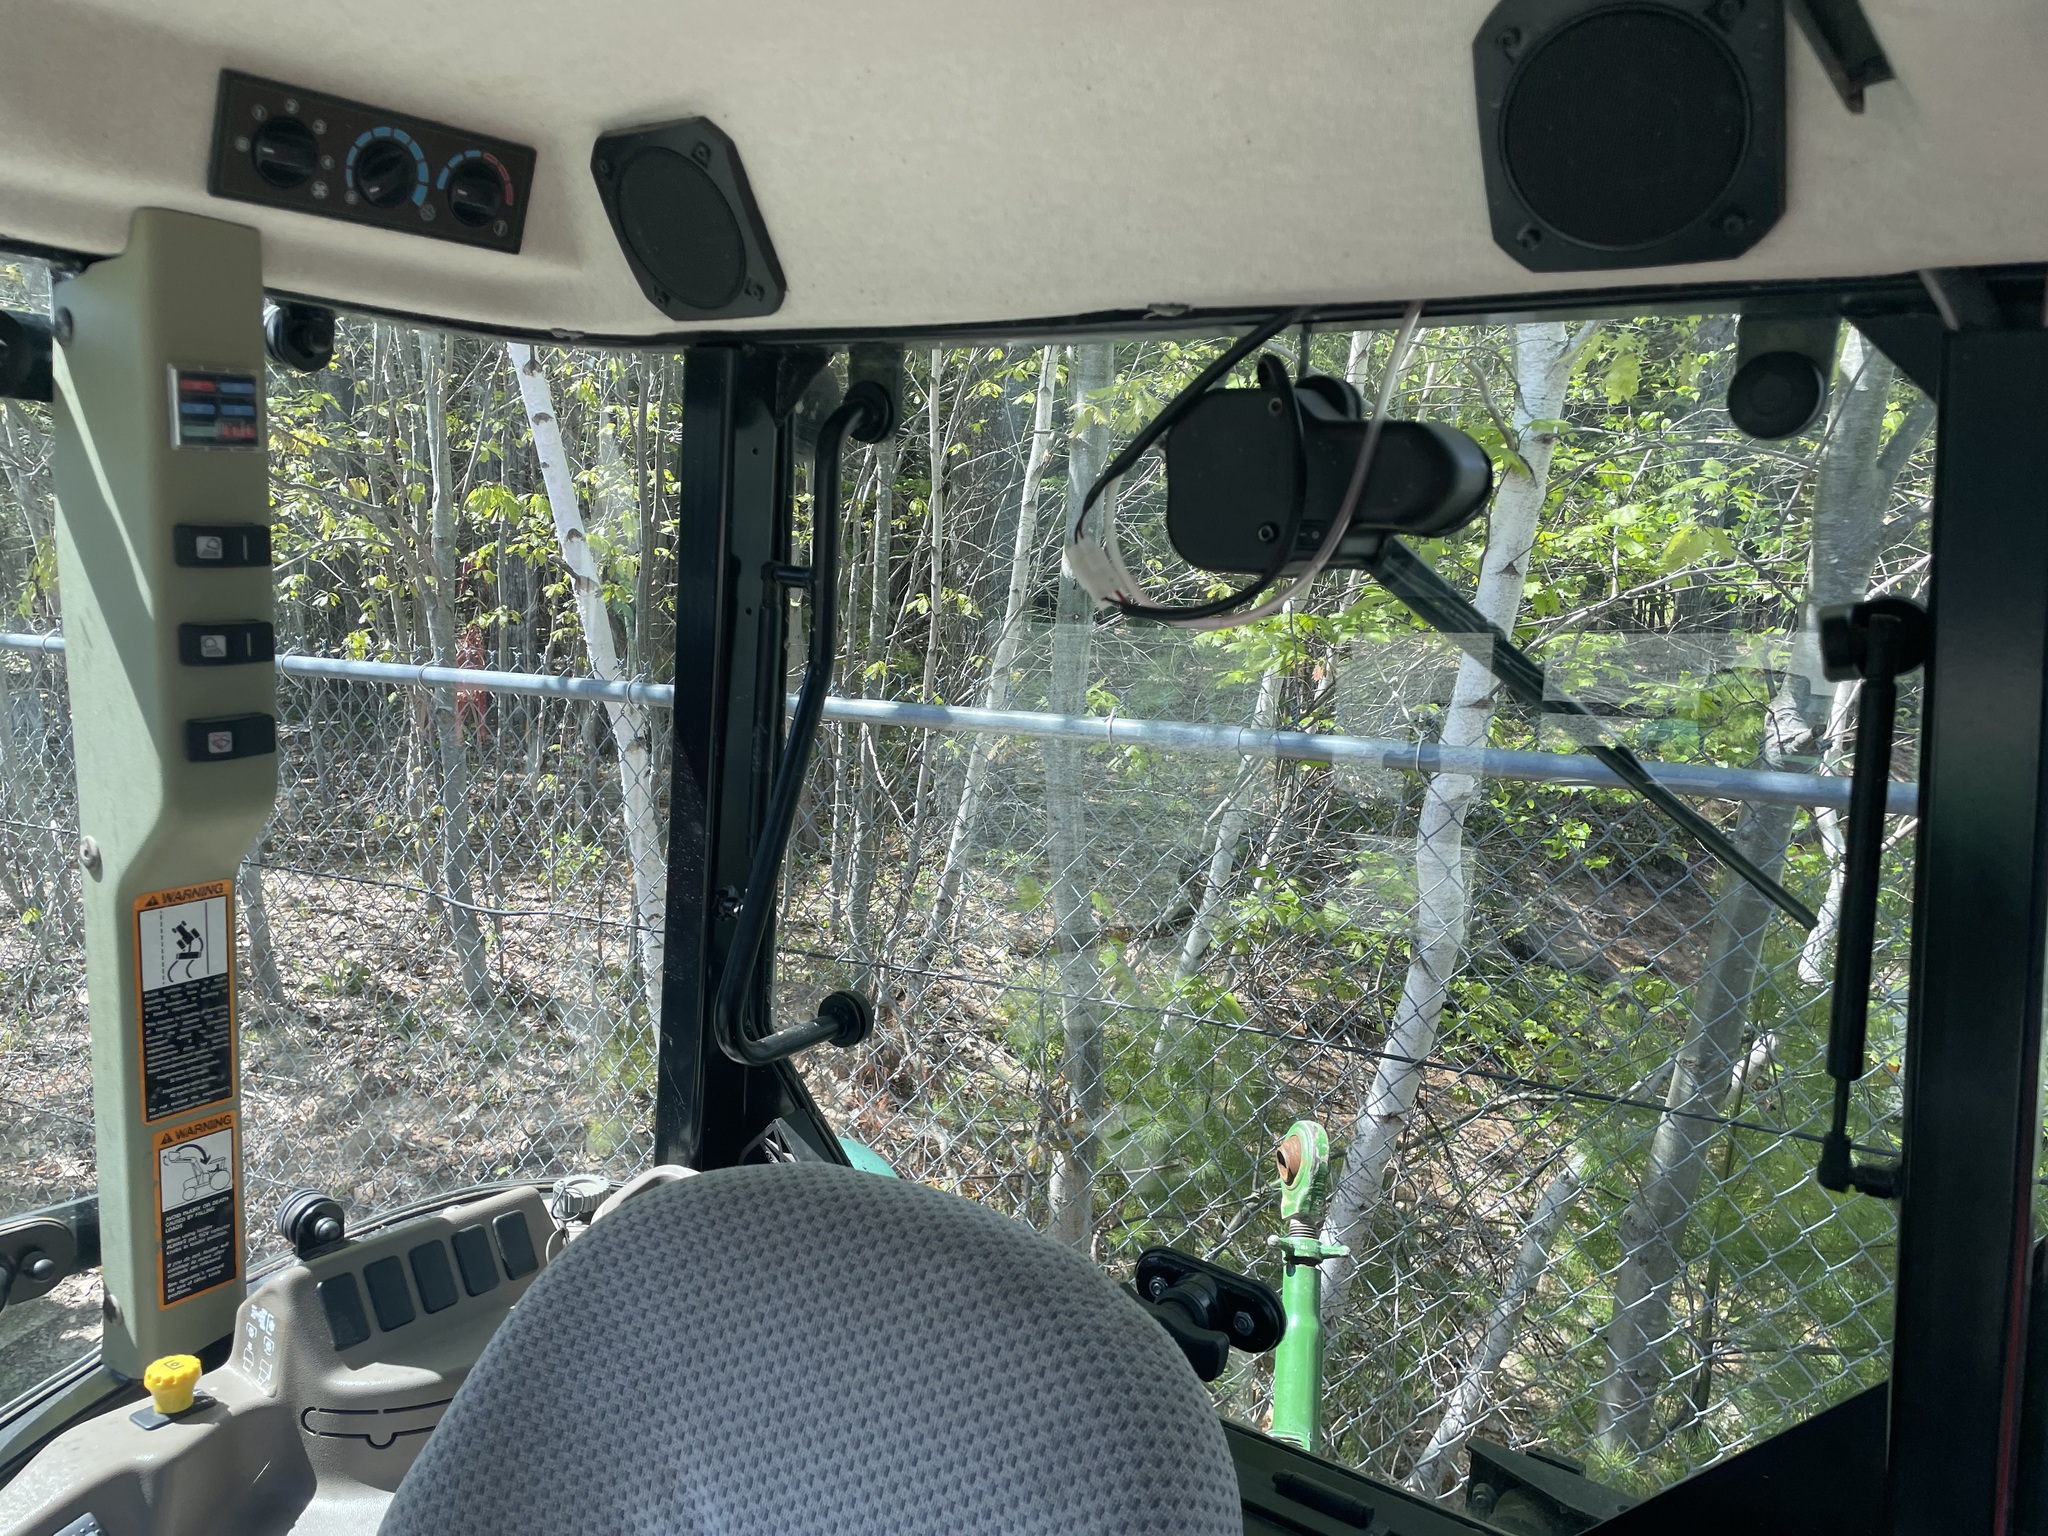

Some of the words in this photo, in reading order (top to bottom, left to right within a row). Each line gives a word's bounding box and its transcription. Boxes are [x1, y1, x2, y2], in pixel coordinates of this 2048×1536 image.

[161, 883, 224, 904] WARNING
[175, 1115, 232, 1139] WARNING
[166, 1213, 181, 1222] AVOID
[212, 1197, 229, 1205] DEATH
[165, 1217, 185, 1227] CAUSED
[165, 1223, 183, 1233] LOADS
